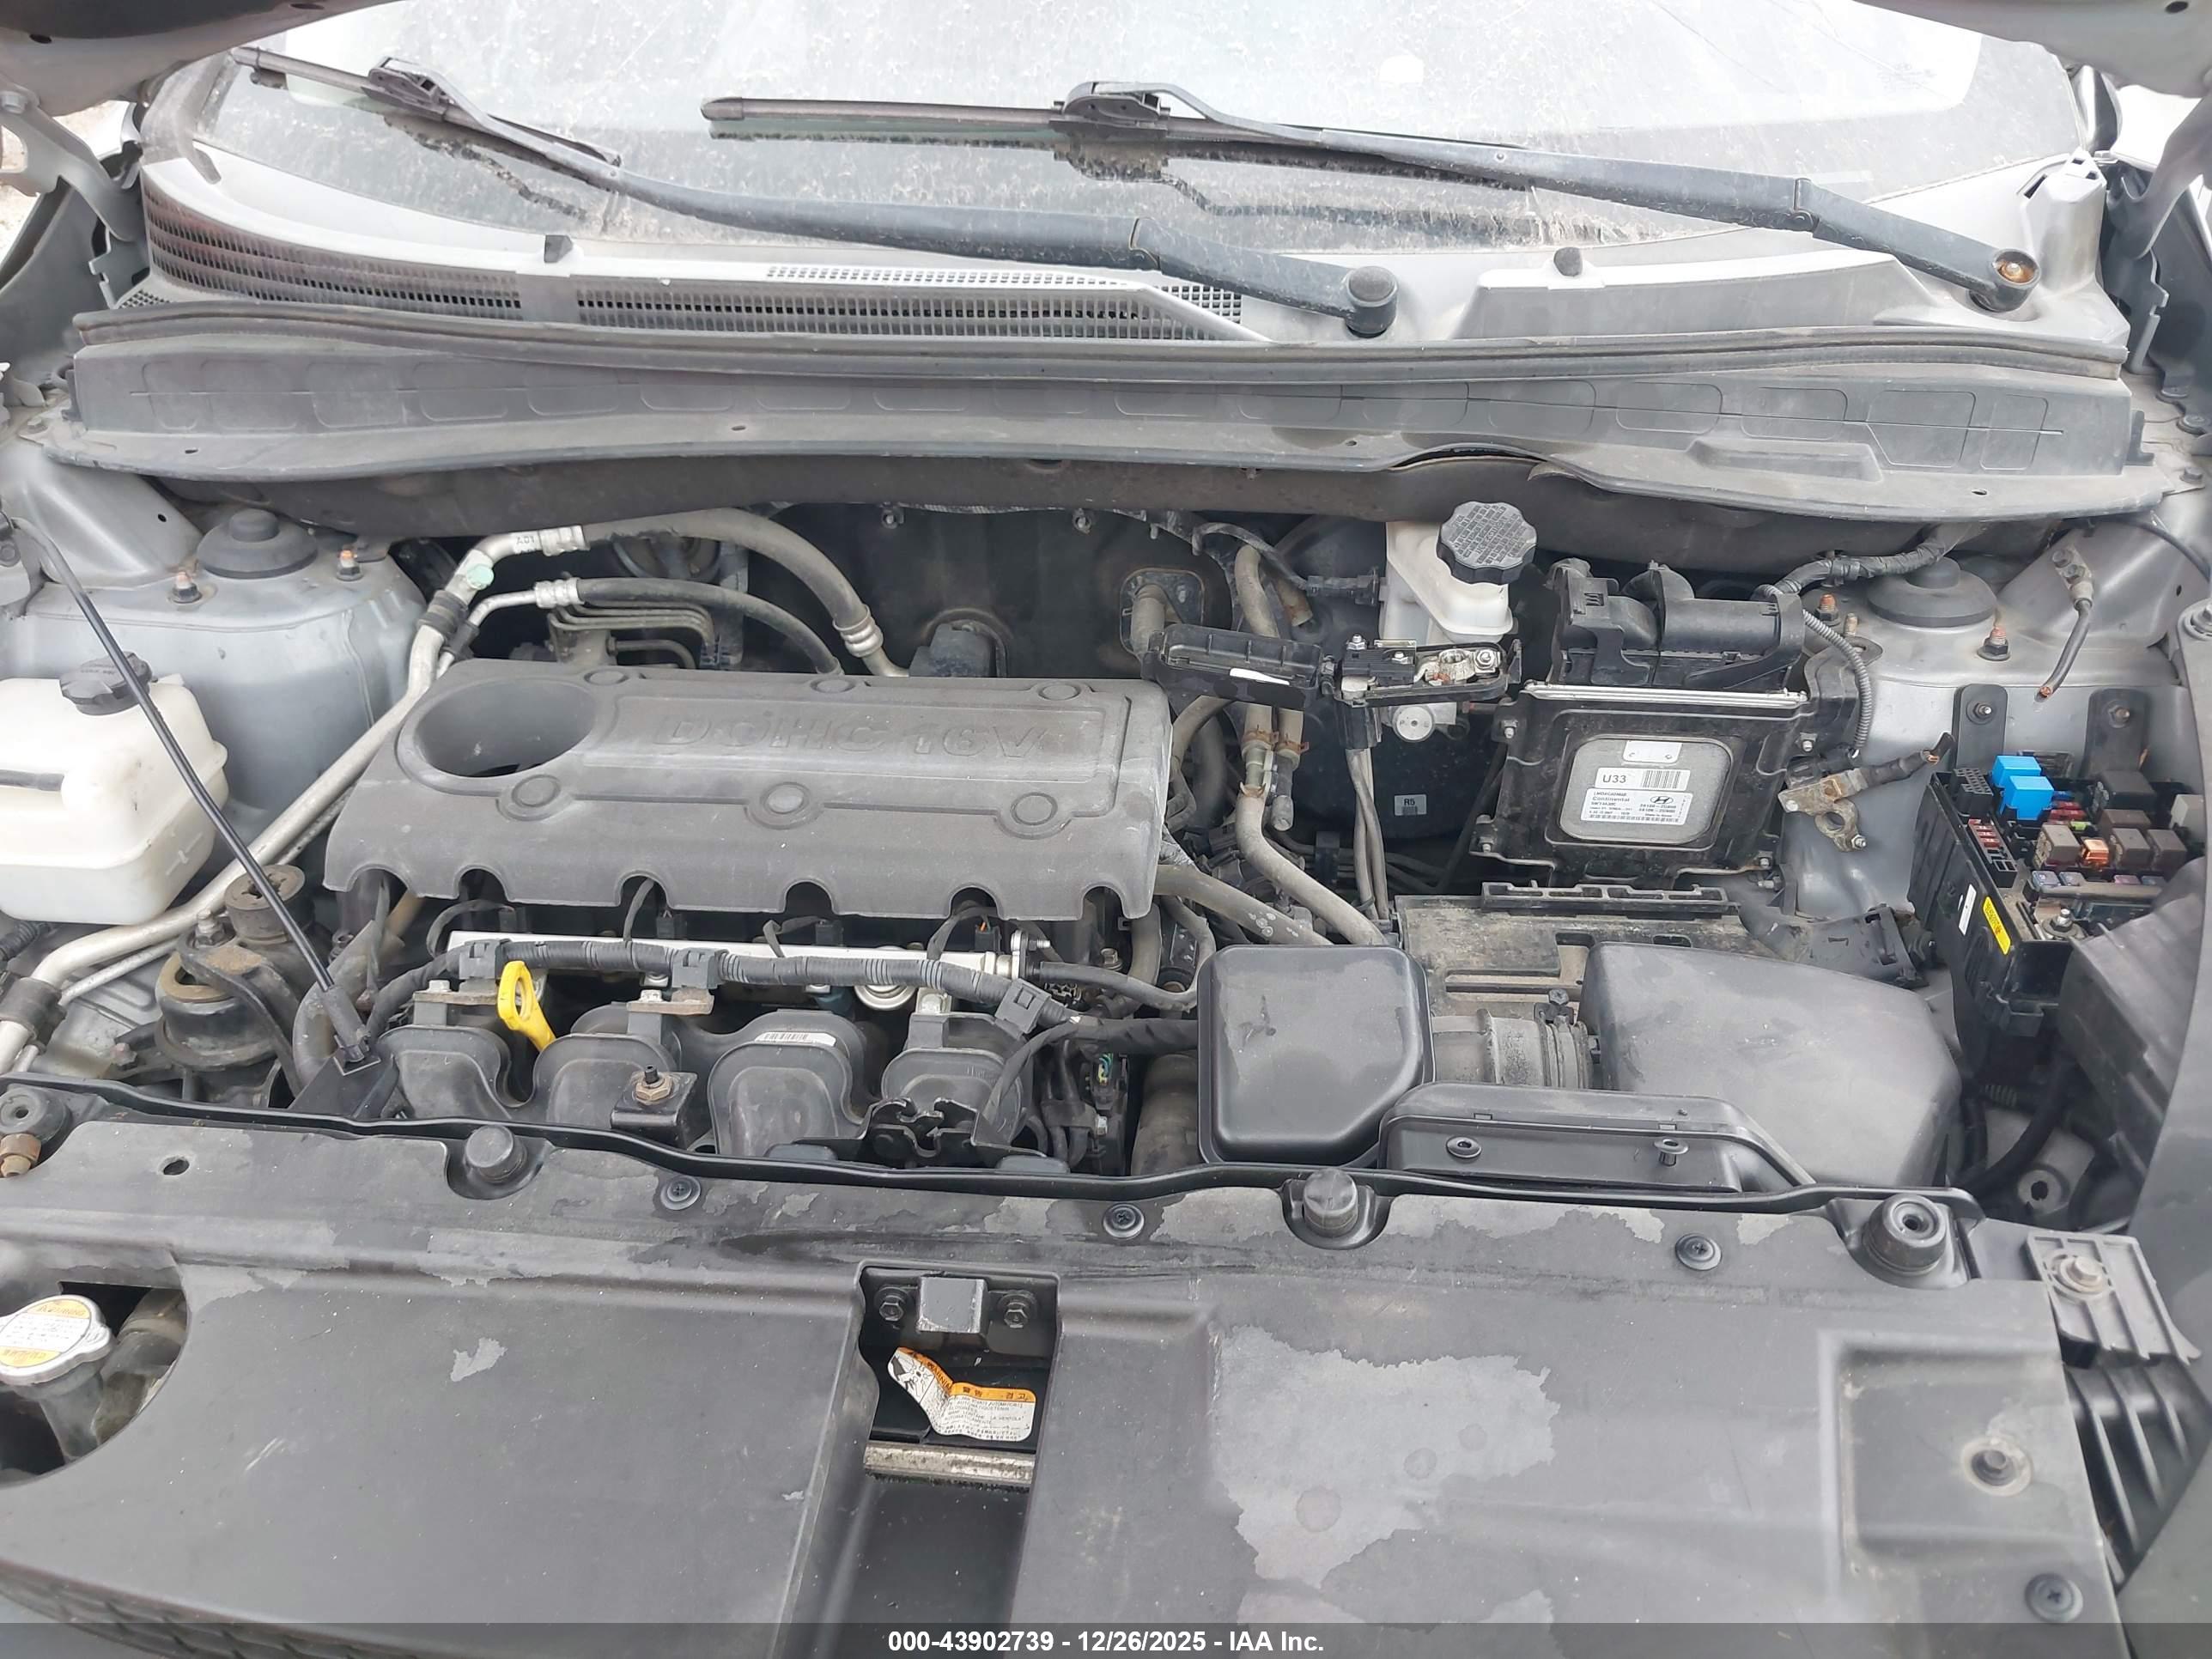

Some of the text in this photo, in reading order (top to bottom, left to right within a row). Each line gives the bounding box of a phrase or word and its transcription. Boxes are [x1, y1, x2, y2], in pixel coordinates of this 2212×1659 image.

[653, 714, 1045, 759] DOHC 16V
[1602, 774, 1626, 784] U33
